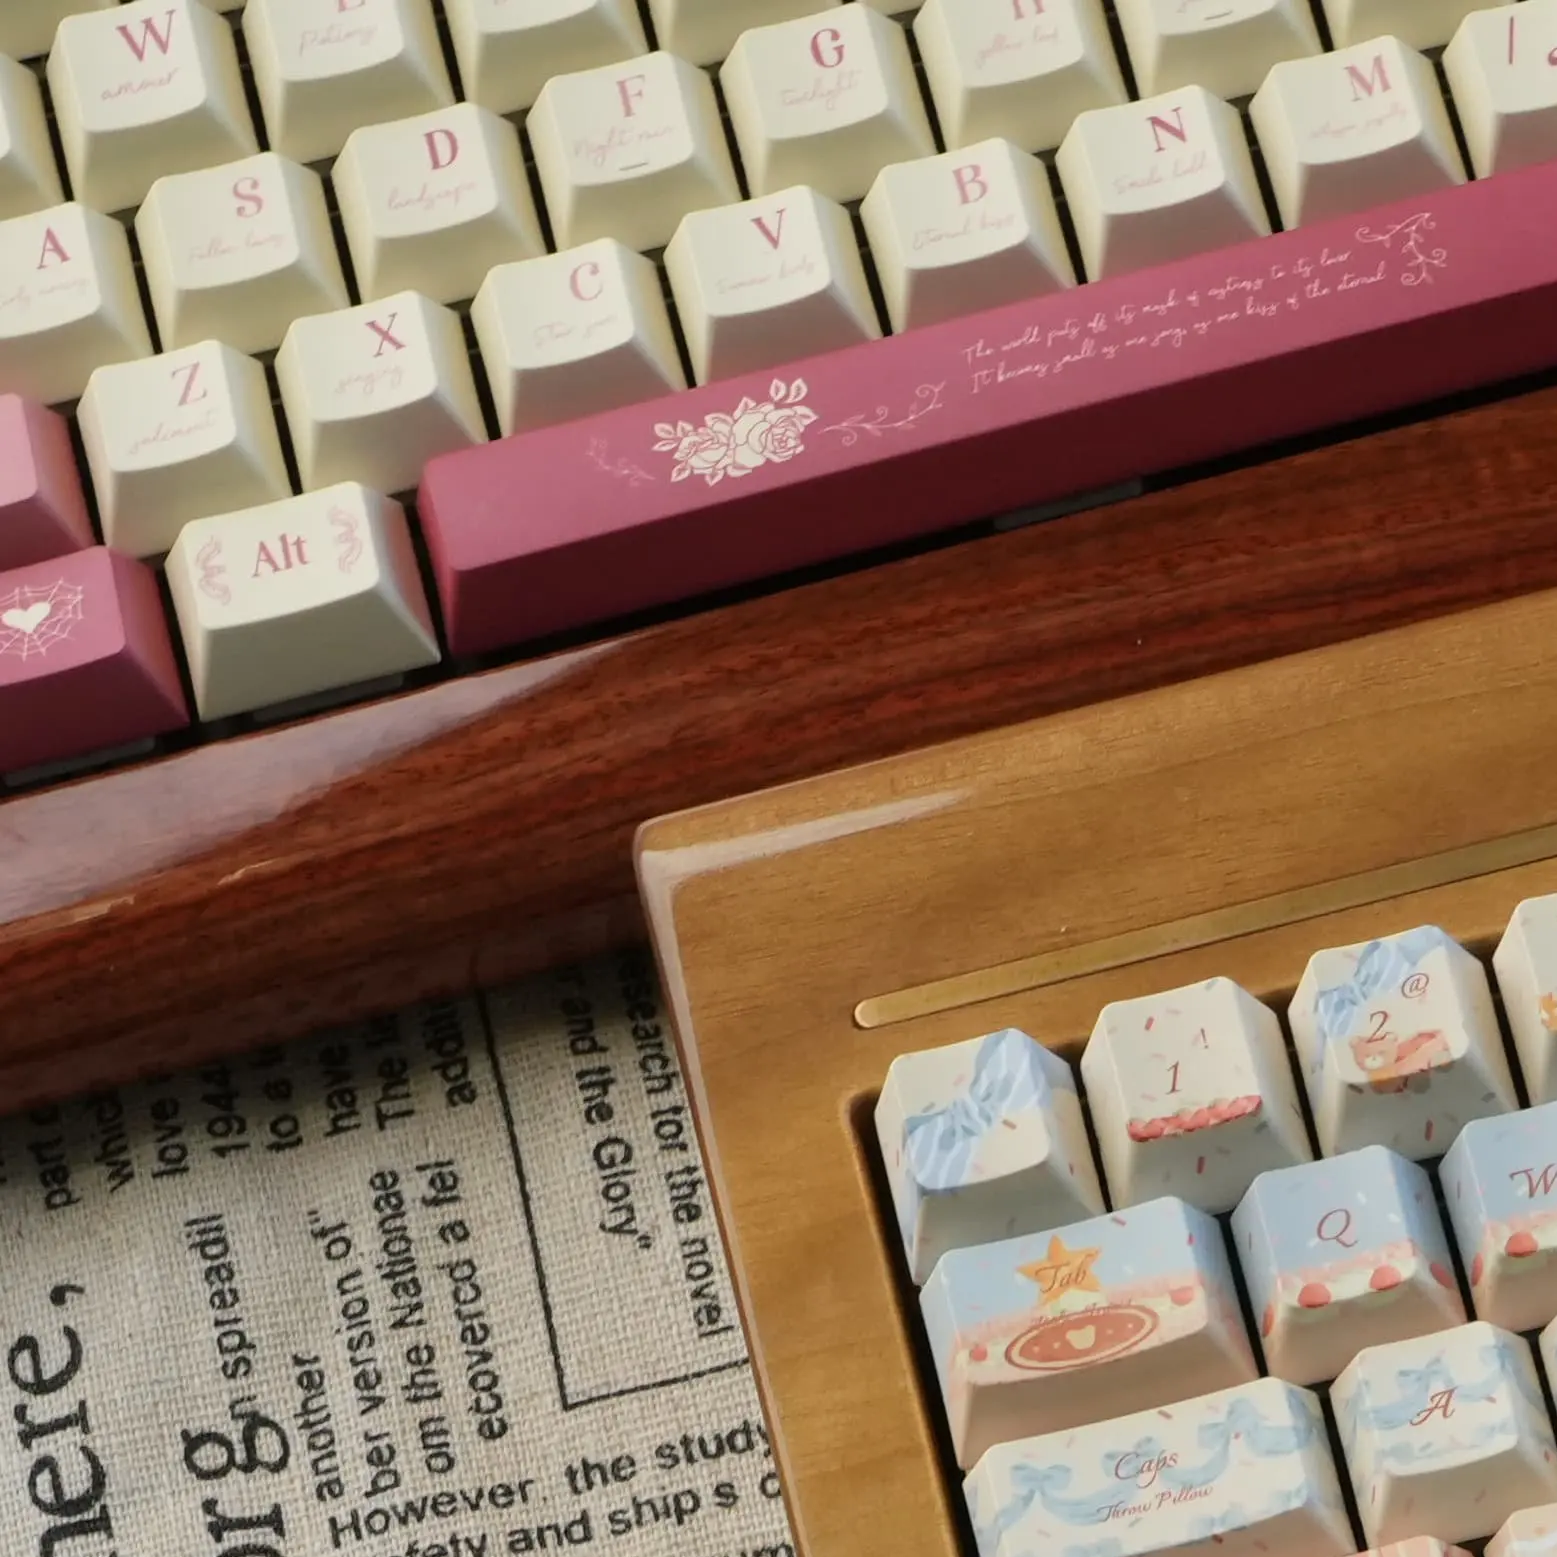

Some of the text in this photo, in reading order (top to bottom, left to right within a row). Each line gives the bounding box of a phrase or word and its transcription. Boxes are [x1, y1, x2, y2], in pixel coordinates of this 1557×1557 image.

[116, 10, 177, 63] W
[809, 27, 845, 69] G
[616, 75, 647, 118] F
[1346, 56, 1394, 103] M
[423, 128, 459, 171] D
[1148, 105, 1188, 153] N
[232, 176, 264, 218] S
[953, 163, 990, 205] B
[36, 227, 71, 270] A
[365, 312, 406, 359] X
[250, 533, 309, 580] Alt
[576, 1067, 613, 1124] the
[652, 1104, 735, 1338] for the novel
[1315, 1208, 1358, 1249] Q
[1036, 1259, 1089, 1293] Tab
[335, 1267, 387, 1416] version
[402, 1344, 442, 1402] the
[294, 1352, 344, 1504] another
[1409, 1387, 1456, 1426] A
[565, 1456, 636, 1496] the
[1115, 1450, 1178, 1489] Caps
[507, 1512, 595, 1554] and
[608, 1486, 700, 1536] ship
